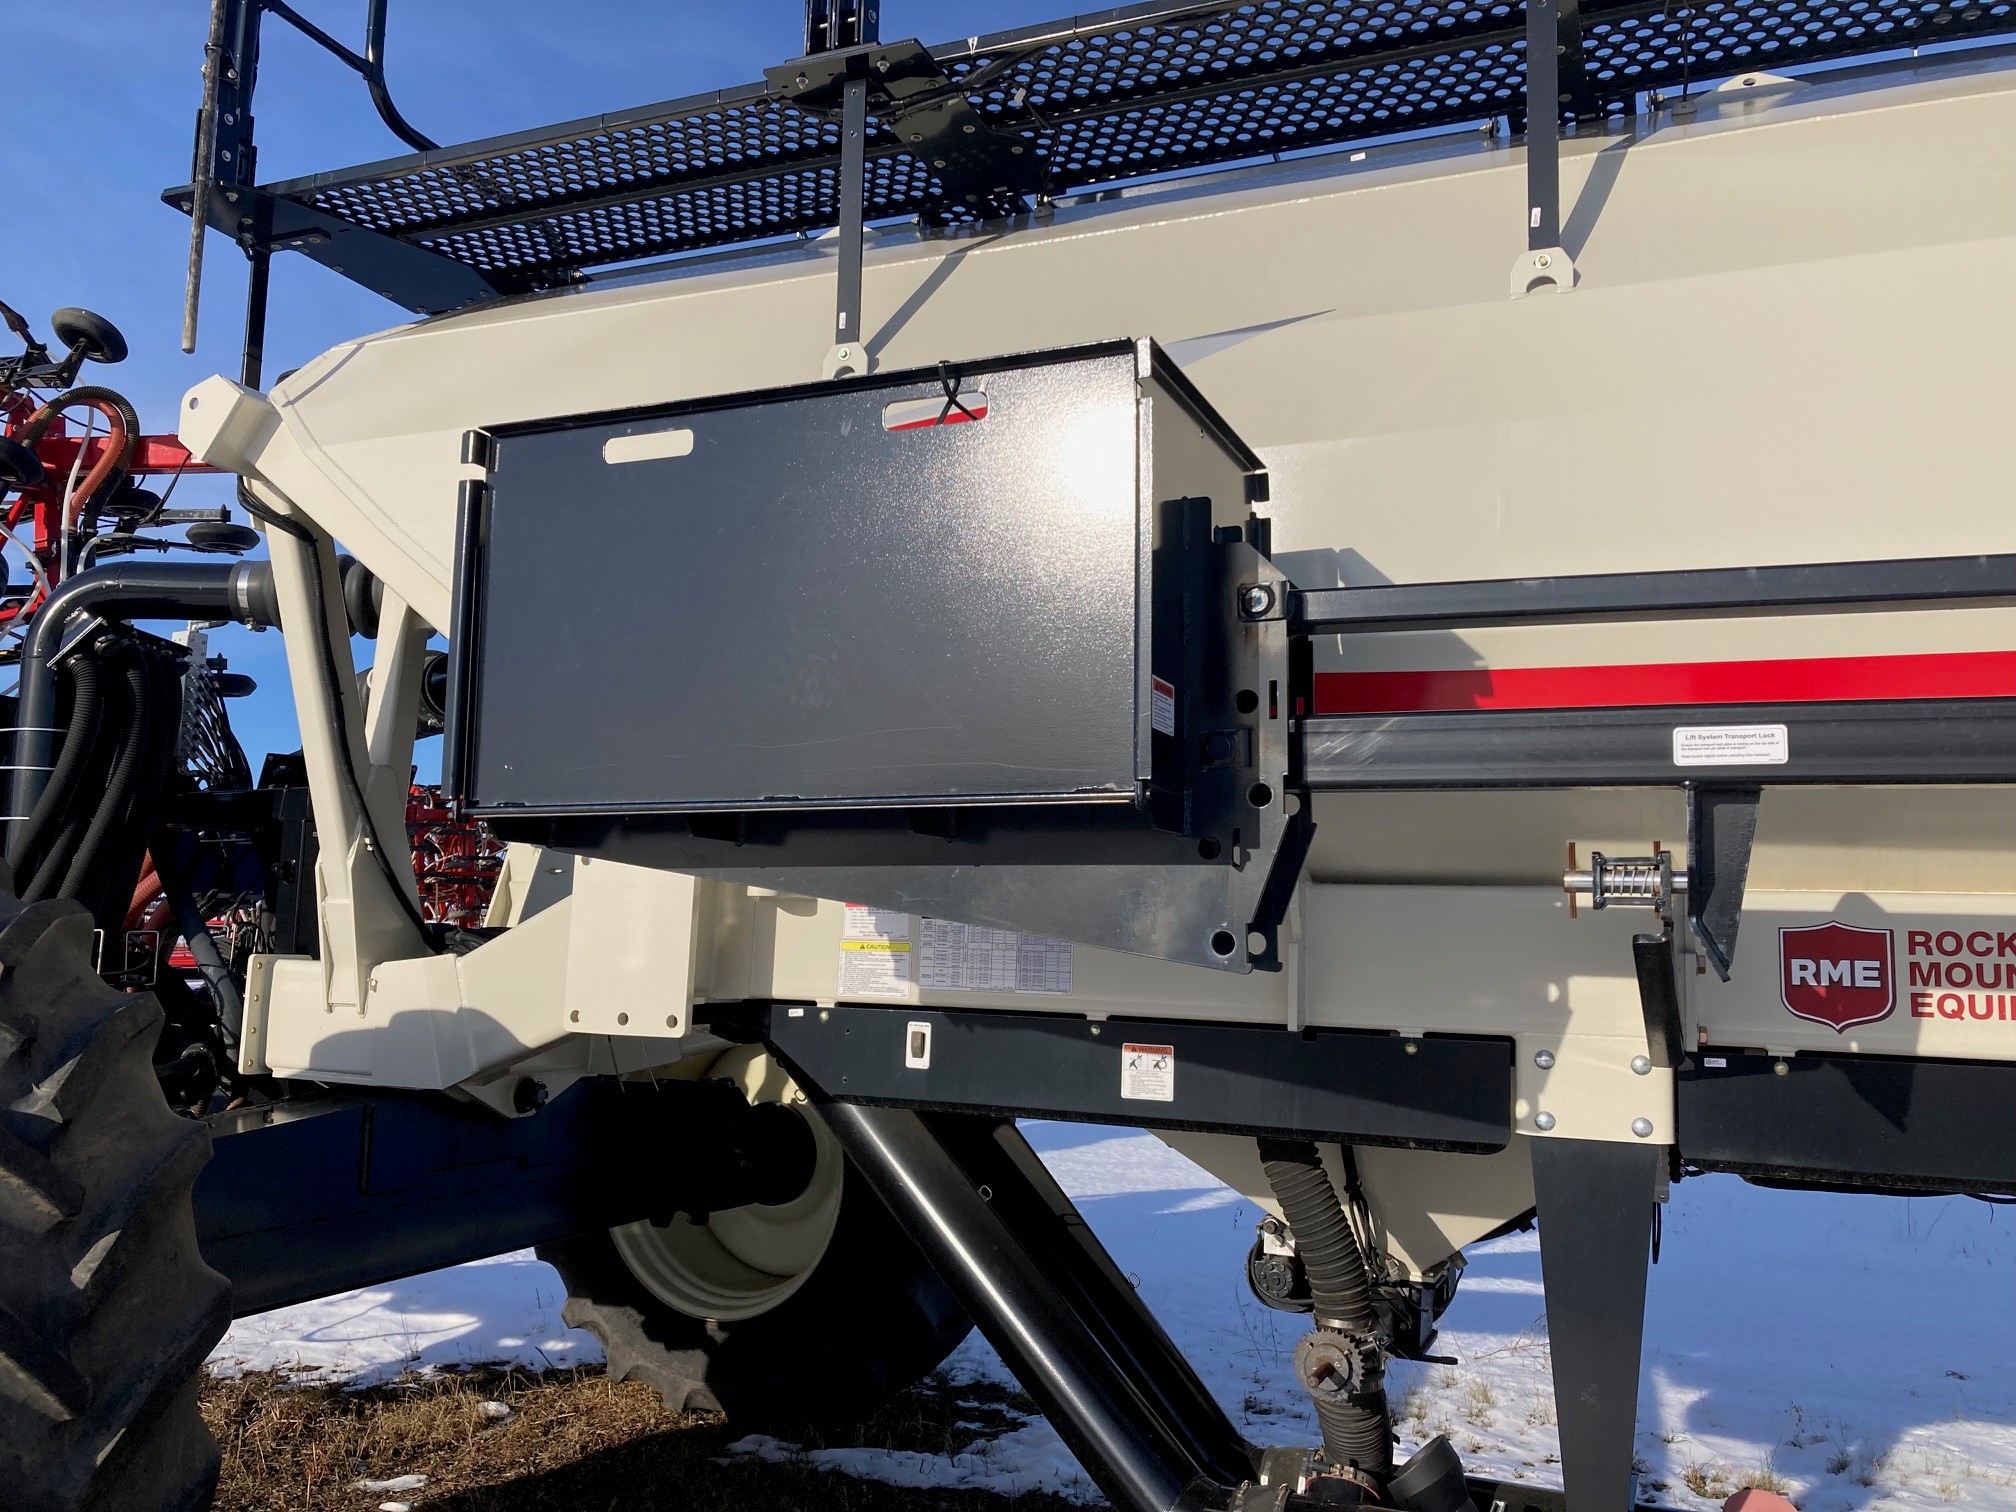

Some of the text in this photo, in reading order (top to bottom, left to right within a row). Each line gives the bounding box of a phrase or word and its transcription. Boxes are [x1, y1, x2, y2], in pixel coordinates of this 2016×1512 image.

[1790, 959, 1882, 988] RME
[1910, 992, 2016, 1021] EQUI
[1138, 1046, 1168, 1054] WARNING
